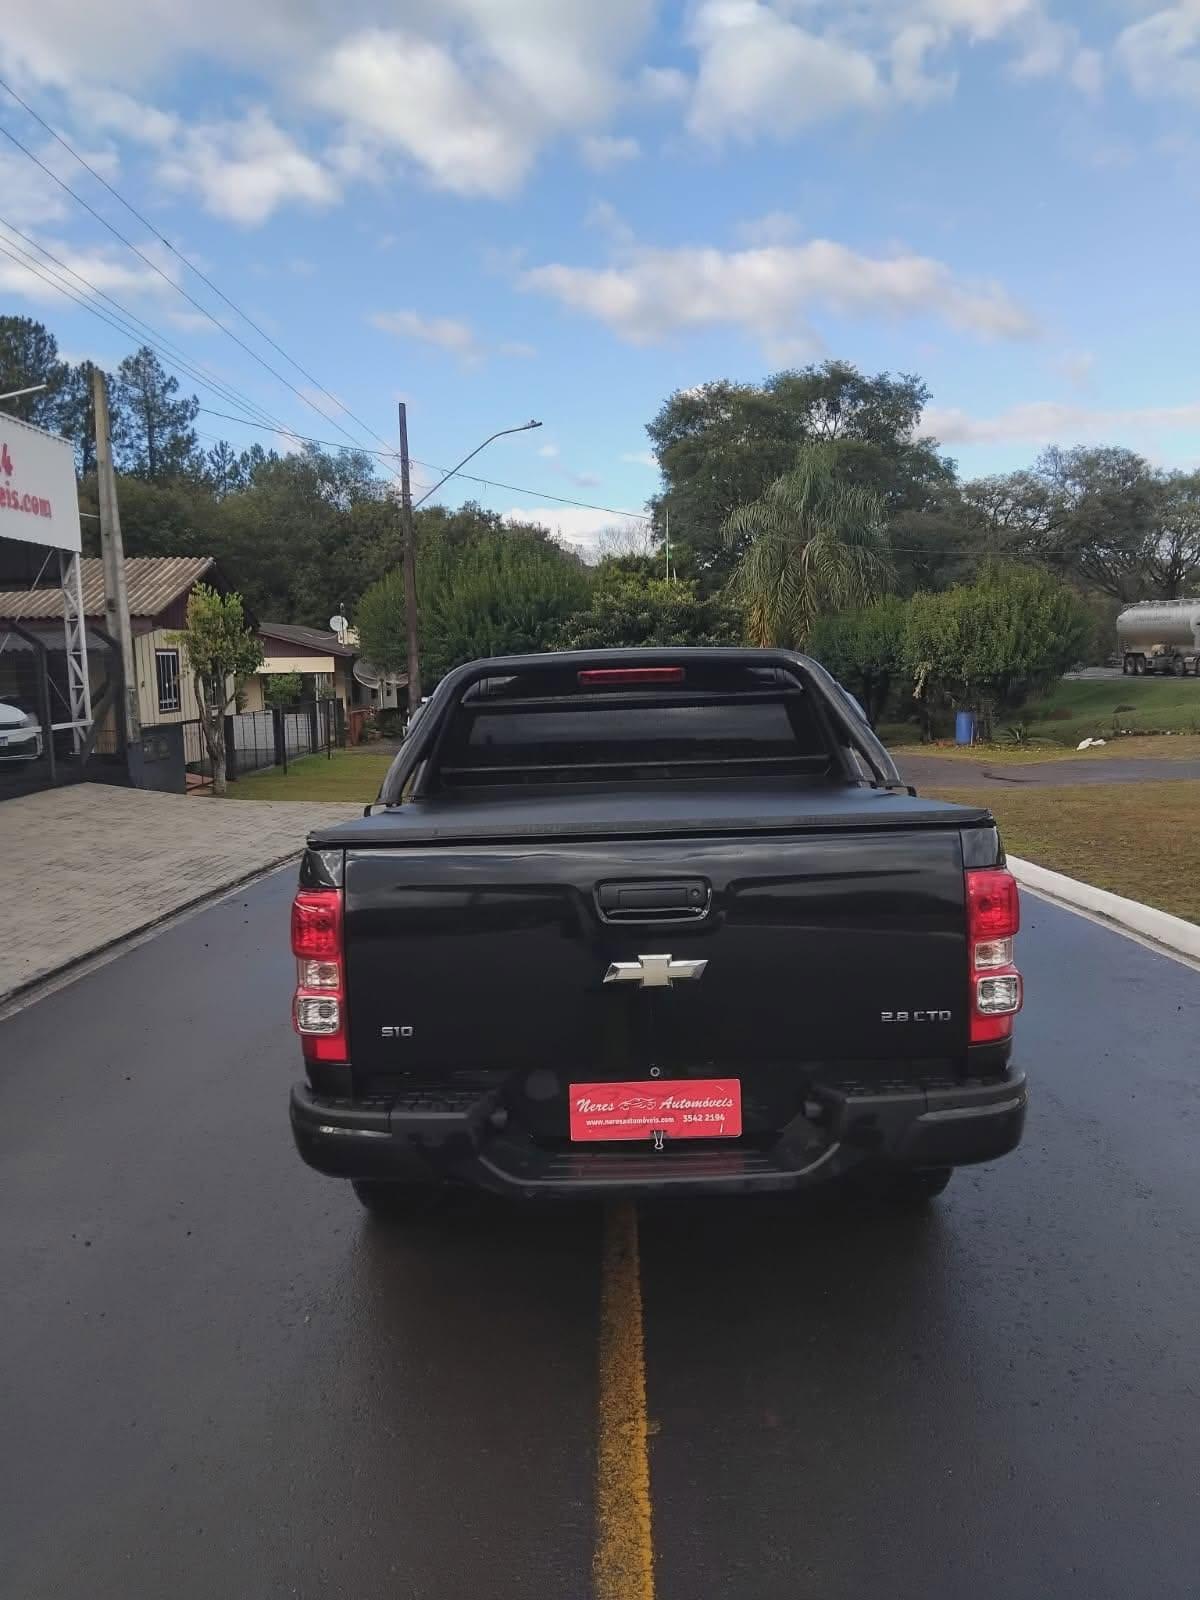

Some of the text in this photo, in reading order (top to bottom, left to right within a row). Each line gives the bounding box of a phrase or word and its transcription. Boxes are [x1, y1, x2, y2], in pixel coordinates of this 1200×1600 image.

[381, 1026, 413, 1037] S10
[576, 1095, 734, 1113] Neres Automóveis
[682, 1114, 703, 1123] 3542
[704, 1113, 726, 1122] 2194
